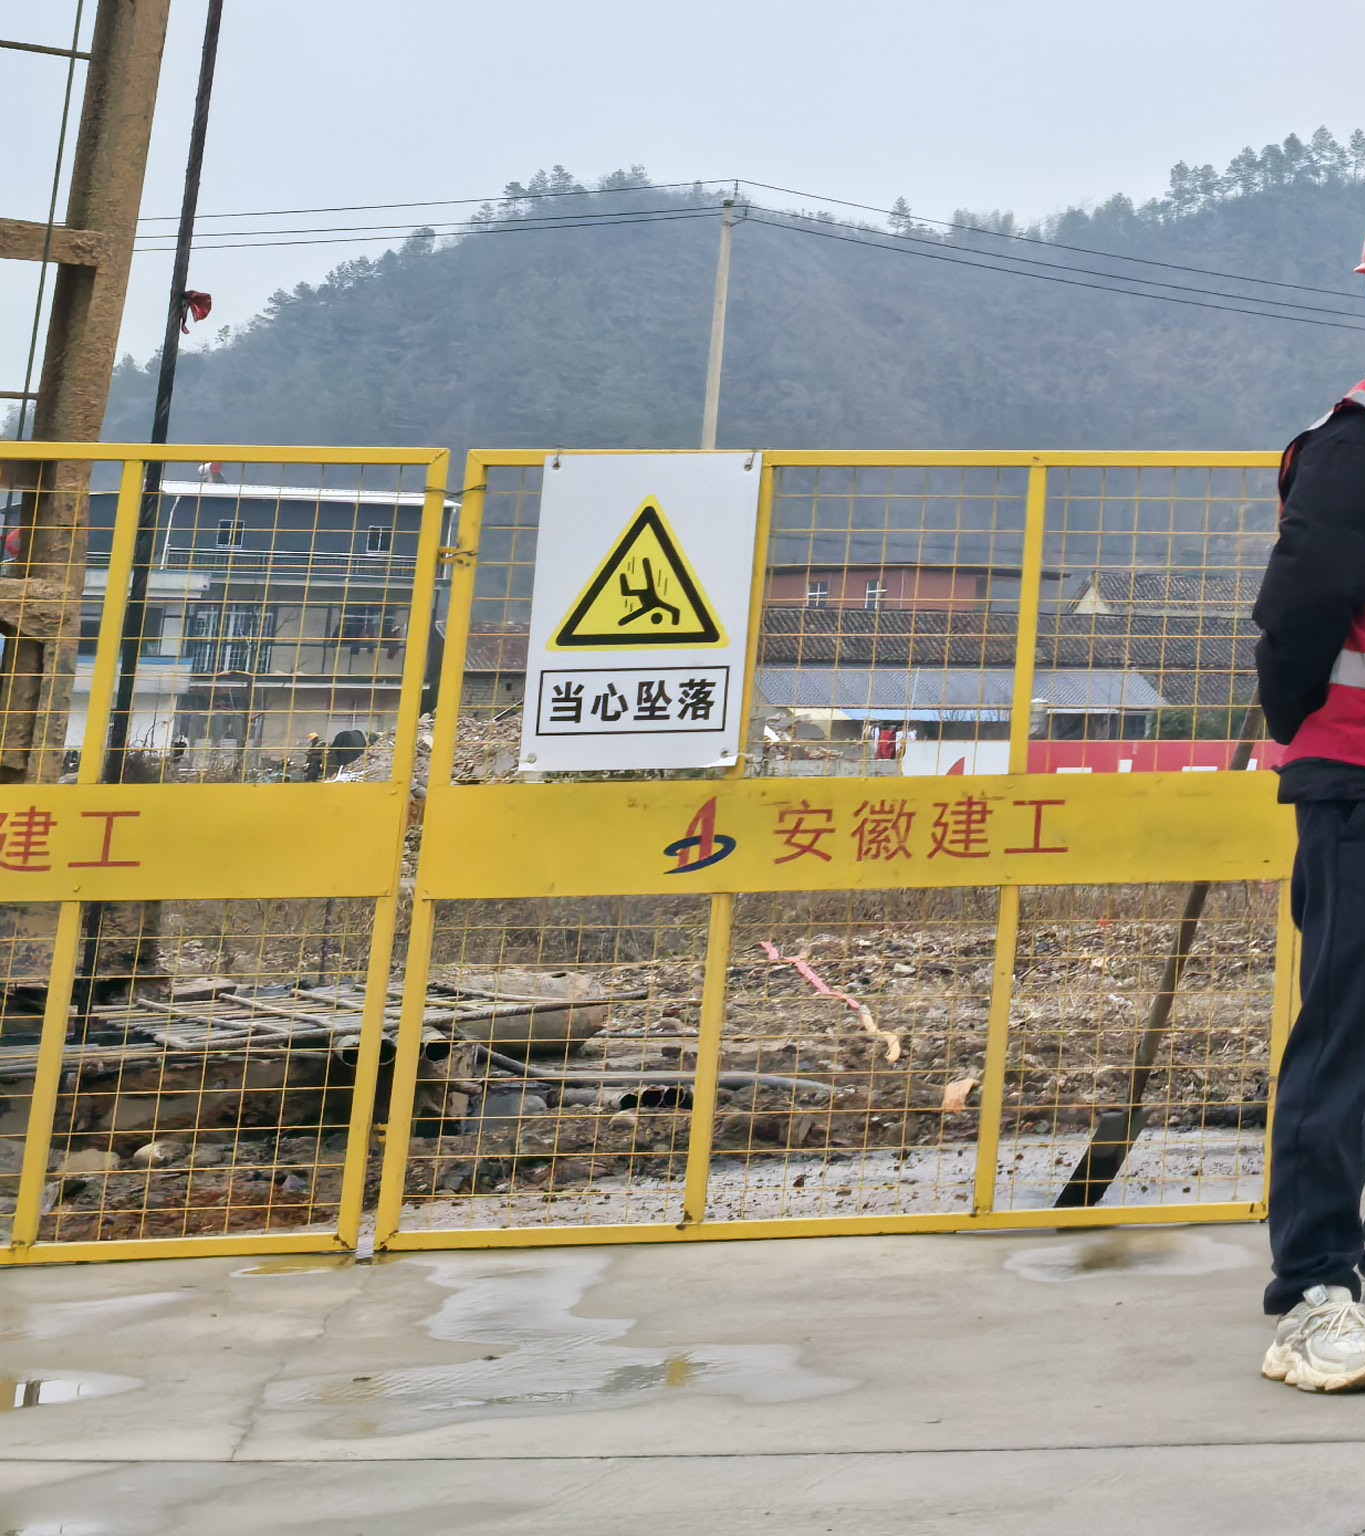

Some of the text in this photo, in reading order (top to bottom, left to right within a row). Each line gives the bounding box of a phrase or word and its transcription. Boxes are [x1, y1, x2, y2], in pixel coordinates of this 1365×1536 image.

[549, 678, 717, 723] 当心坠落
[772, 795, 1068, 865] 安徽建工
